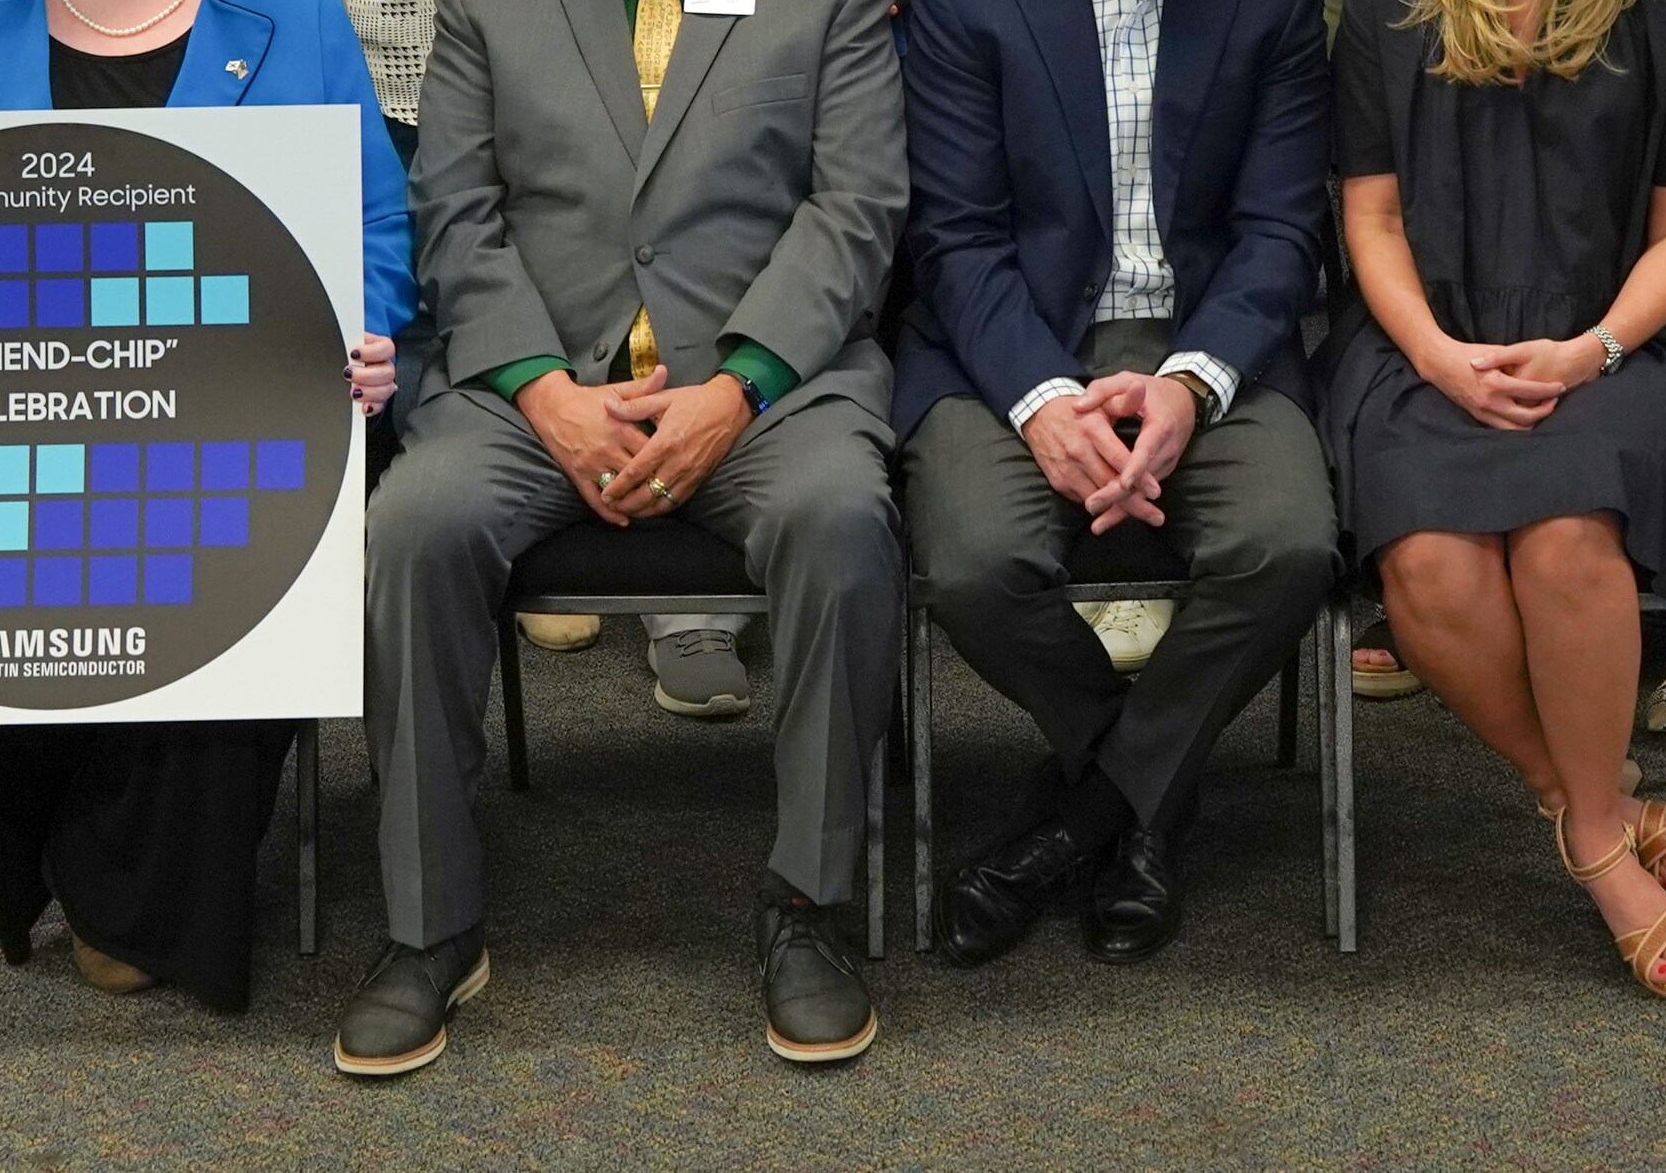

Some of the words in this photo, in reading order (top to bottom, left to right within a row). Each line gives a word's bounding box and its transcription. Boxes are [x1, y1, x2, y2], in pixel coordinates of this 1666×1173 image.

[21, 152, 96, 179] 2024
[78, 183, 196, 212] Recipient
[23, 660, 146, 678] SEMICONDUCTOR
